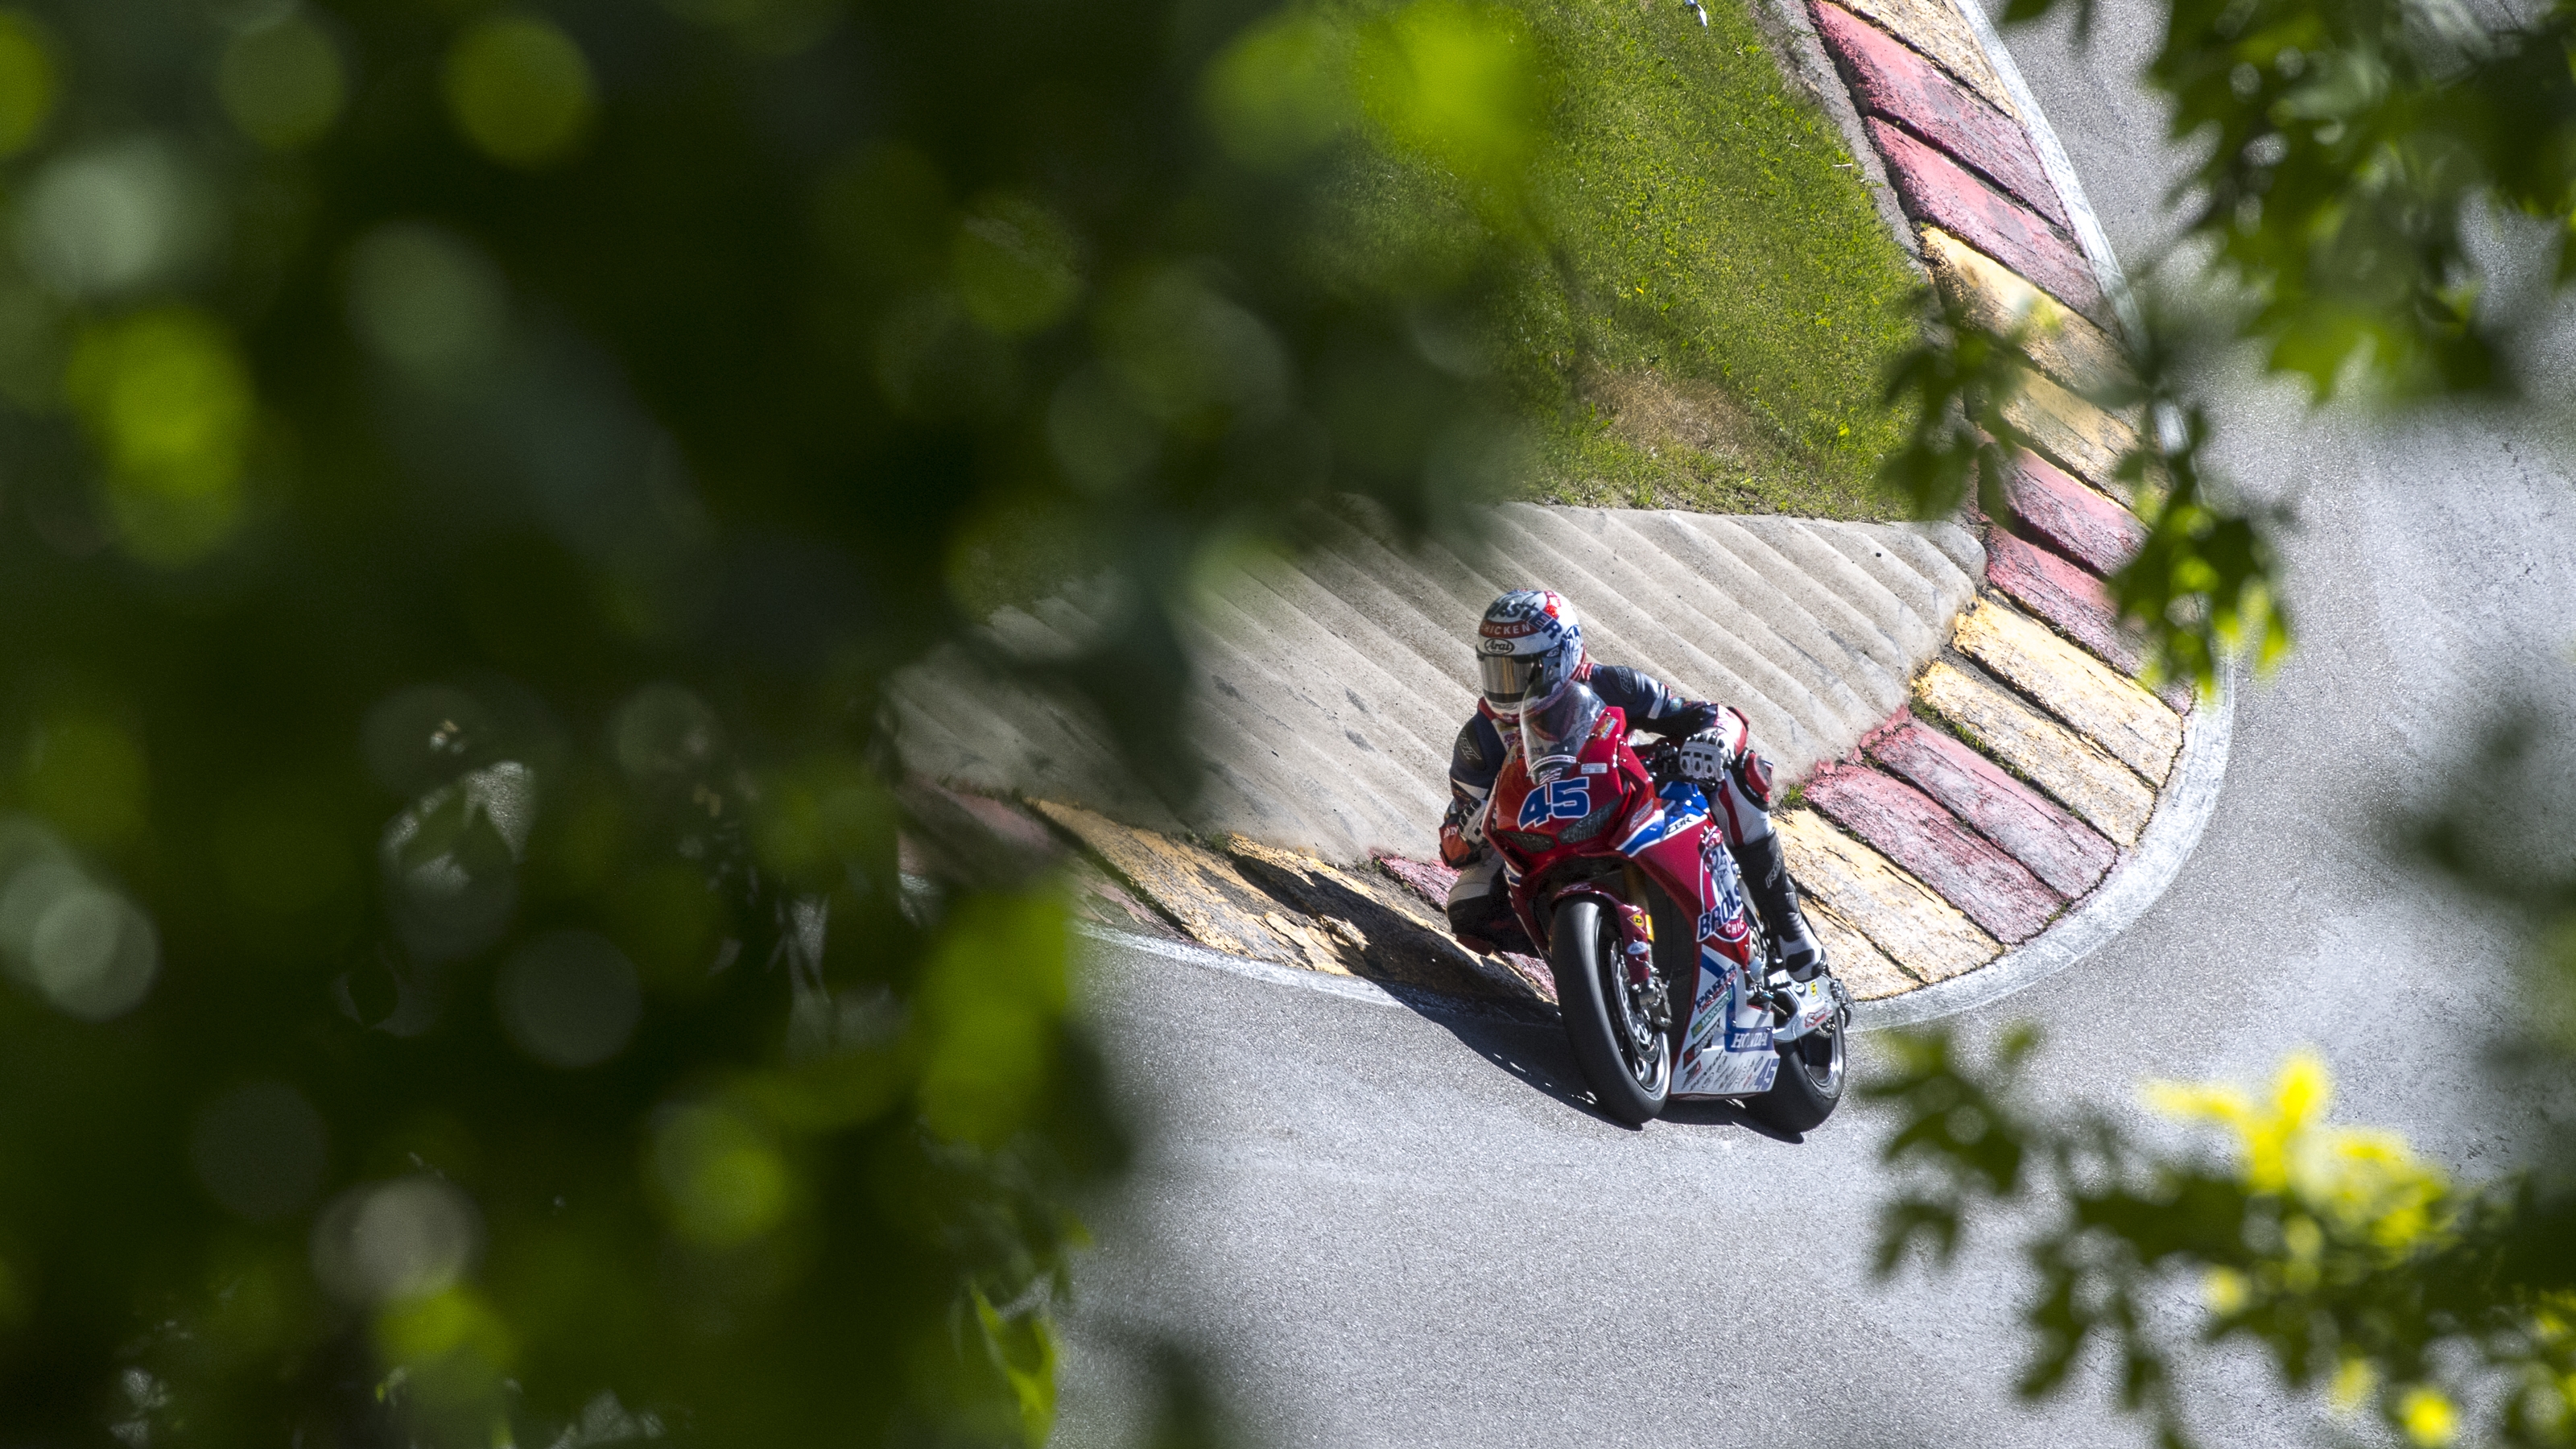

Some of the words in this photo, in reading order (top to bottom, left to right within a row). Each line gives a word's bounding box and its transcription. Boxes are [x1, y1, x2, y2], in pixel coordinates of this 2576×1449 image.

[1488, 640, 1510, 650] Arai
[1517, 777, 1590, 831] 45
[1731, 1032, 1768, 1049] HONDA
[1754, 1059, 1780, 1092] 45
